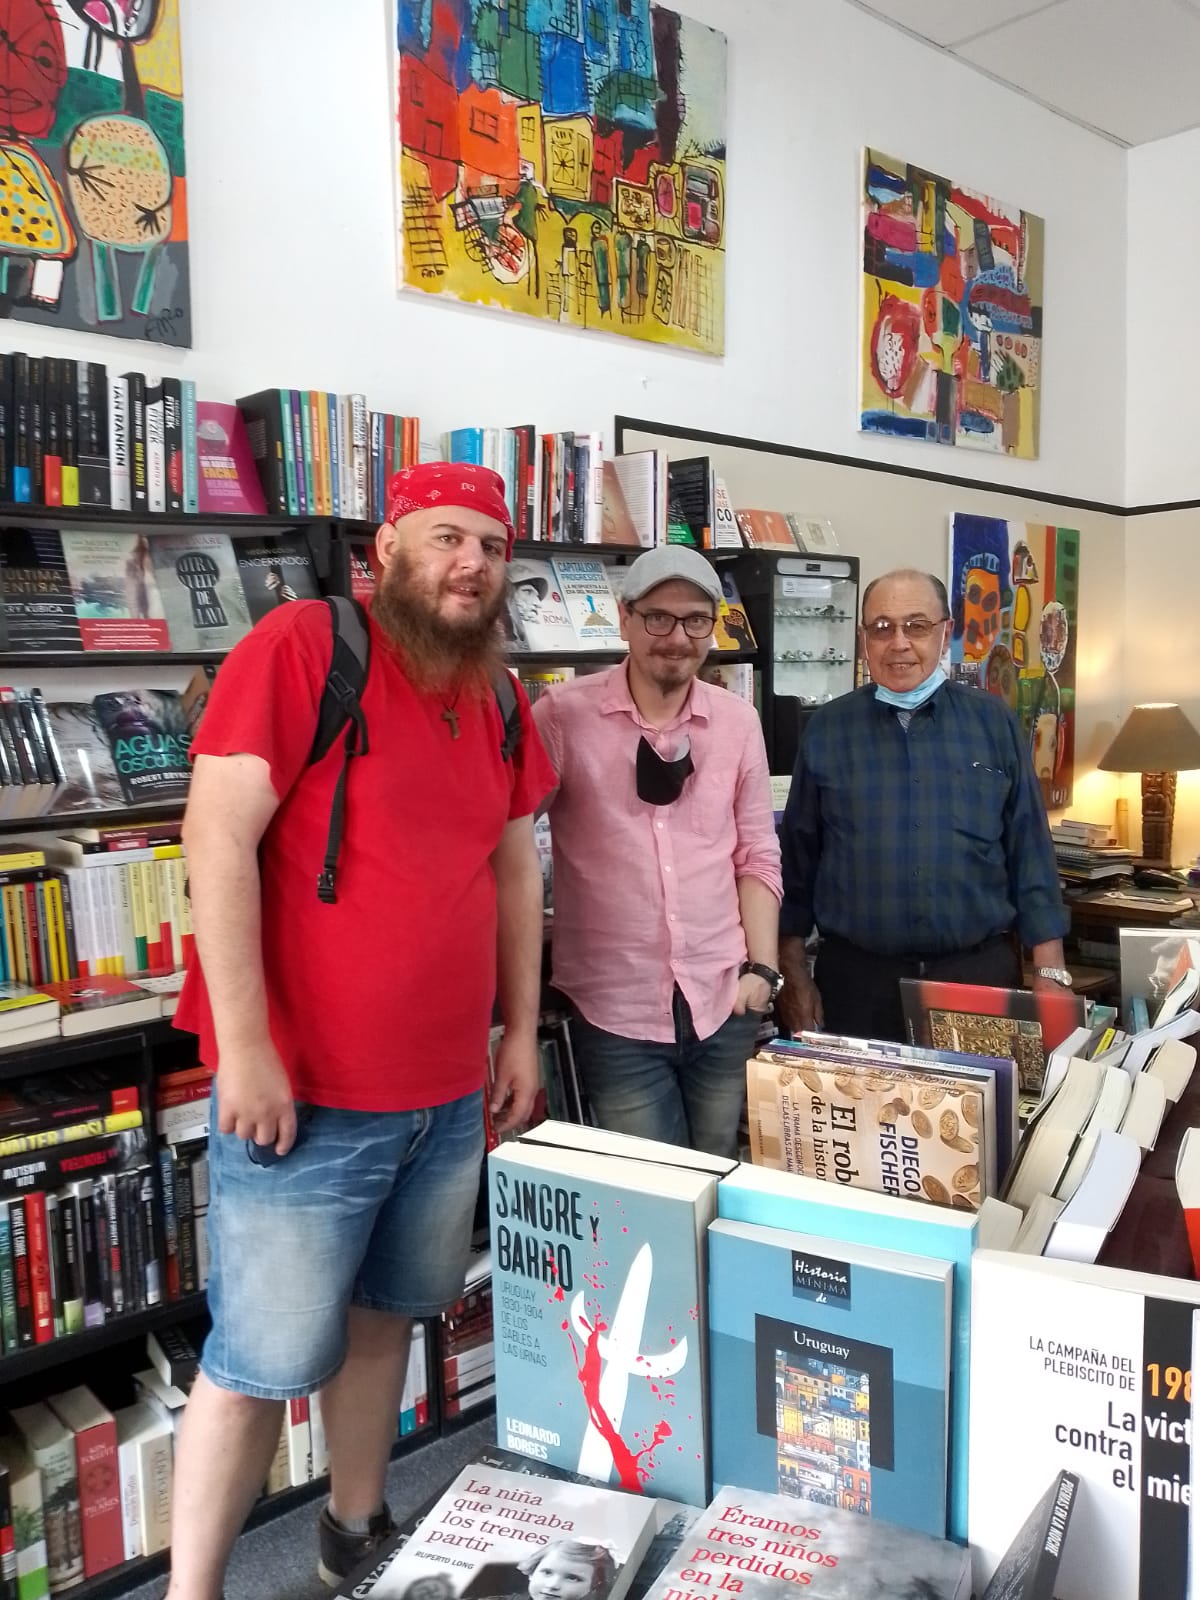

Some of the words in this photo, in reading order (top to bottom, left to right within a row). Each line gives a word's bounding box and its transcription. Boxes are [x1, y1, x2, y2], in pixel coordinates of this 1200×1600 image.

[113, 385, 122, 410] IAN
[148, 407, 159, 444] FITZEK
[165, 395, 175, 429] FITZEK
[114, 412, 125, 467] RANKIN
[239, 556, 310, 568] ENCERRADOS
[115, 733, 192, 760] AGUAS
[119, 753, 192, 774] OSCURA
[781, 1095, 788, 1105] DE
[782, 1106, 790, 1120] LAS
[792, 1102, 800, 1112] LA
[811, 1095, 828, 1116] de
[792, 1112, 801, 1134] TRAMA
[812, 1119, 828, 1133] la
[830, 1103, 857, 1132] El
[783, 1120, 791, 1145] LIBRAS
[785, 1146, 792, 1156] DE
[832, 1139, 860, 1186] rob
[879, 1122, 900, 1196] FISCHER
[901, 1135, 921, 1192] DIEGO
[496, 1171, 584, 1241] SANGRE
[590, 1216, 600, 1242] Y
[497, 1225, 574, 1292] BARRO
[795, 1259, 848, 1284] Historia
[501, 1296, 543, 1320] 1830-1904
[816, 1293, 828, 1304] de
[502, 1315, 512, 1328] DE
[512, 1316, 529, 1332] LOS
[502, 1326, 532, 1349] SABLES
[534, 1337, 542, 1349] A
[793, 1331, 850, 1358] Uruguay
[502, 1341, 518, 1358] LAS
[519, 1346, 548, 1368] URNAS
[1029, 1335, 1044, 1352] LA
[1047, 1339, 1107, 1368] CAMPAÑA
[1112, 1354, 1136, 1374] DEL
[1044, 1357, 1115, 1387] PLEBISCITO
[1119, 1376, 1136, 1392] DE
[1107, 1401, 1136, 1433] La
[506, 1417, 561, 1447] LEONARDO
[1055, 1423, 1133, 1462] contra
[507, 1434, 549, 1460] BORGES
[1112, 1464, 1135, 1492] el
[464, 1480, 491, 1496] La
[495, 1487, 543, 1507] niña
[1057, 1478, 1074, 1509] POEMAS
[453, 1497, 492, 1514] que
[496, 1505, 575, 1533] miraba
[718, 1505, 822, 1541] Éramos
[1051, 1516, 1064, 1529] LA
[1055, 1506, 1066, 1520] EN
[424, 1529, 494, 1553] partir
[440, 1511, 474, 1530] los
[479, 1522, 550, 1546] trenes
[1045, 1527, 1062, 1557] NOCHE
[415, 1550, 451, 1564] RUPERTO
[451, 1560, 475, 1571] LONG
[706, 1526, 758, 1548] tres
[762, 1540, 839, 1569] niños
[689, 1546, 815, 1586] perdidos
[679, 1567, 712, 1587] en
[716, 1572, 745, 1593] la
